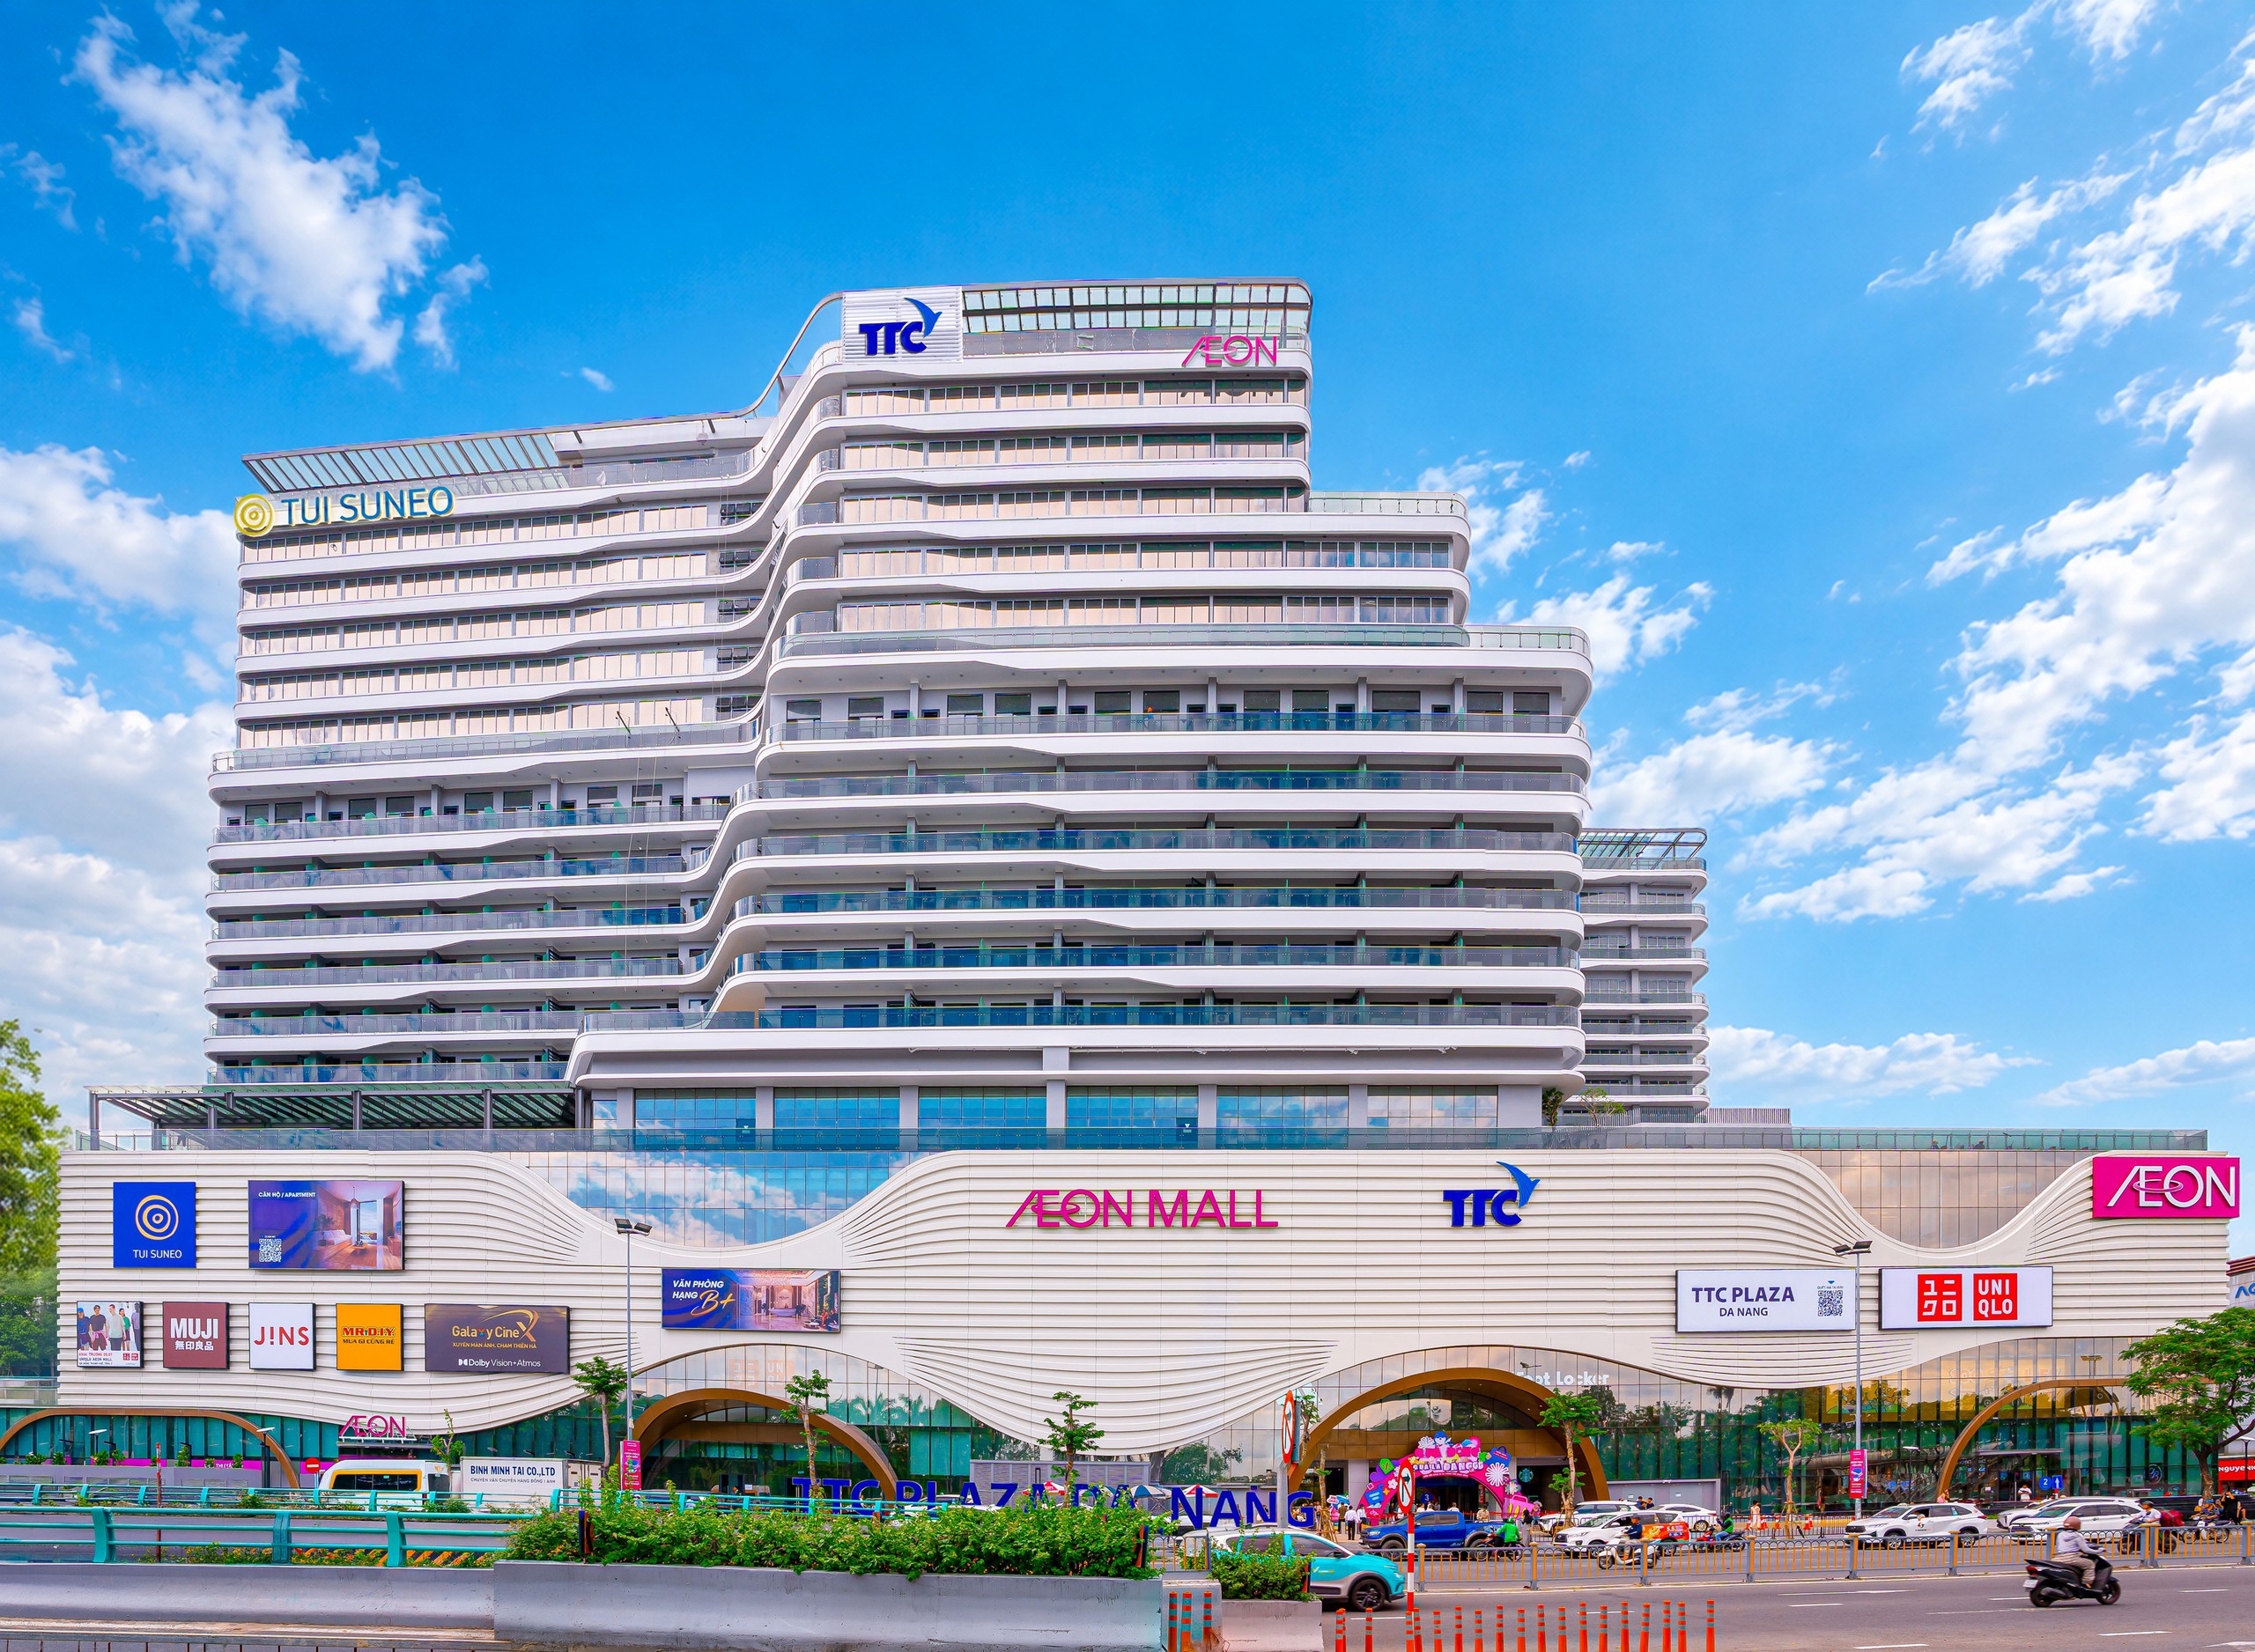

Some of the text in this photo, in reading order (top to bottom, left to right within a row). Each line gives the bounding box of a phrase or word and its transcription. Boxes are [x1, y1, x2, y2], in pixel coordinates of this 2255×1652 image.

[859, 321, 927, 356] TTC
[280, 486, 455, 526] TUI SUNEO
[1148, 1189, 1278, 1228] MALL
[1443, 1190, 1522, 1228] TTC
[133, 1250, 182, 1258] TUI SUNEO
[673, 1278, 725, 1288] VĂN PHÒNG
[1978, 1279, 2010, 1295] UNI
[672, 1291, 699, 1301] HẠNG
[691, 1289, 736, 1316] B+
[1691, 1287, 1795, 1303] TTC PLAZA
[1719, 1307, 1769, 1317] DA NANG
[1978, 1298, 2013, 1318] QLO
[170, 1317, 219, 1339] MUJI
[174, 1340, 214, 1352] 無印良品
[469, 1358, 491, 1368] Dolby
[1556, 1371, 1609, 1385] Locker
[491, 1465, 510, 1475] MINH
[2043, 1478, 2049, 1486] 2
[793, 1478, 880, 1515] TTC
[1171, 1486, 1315, 1529] NANG
